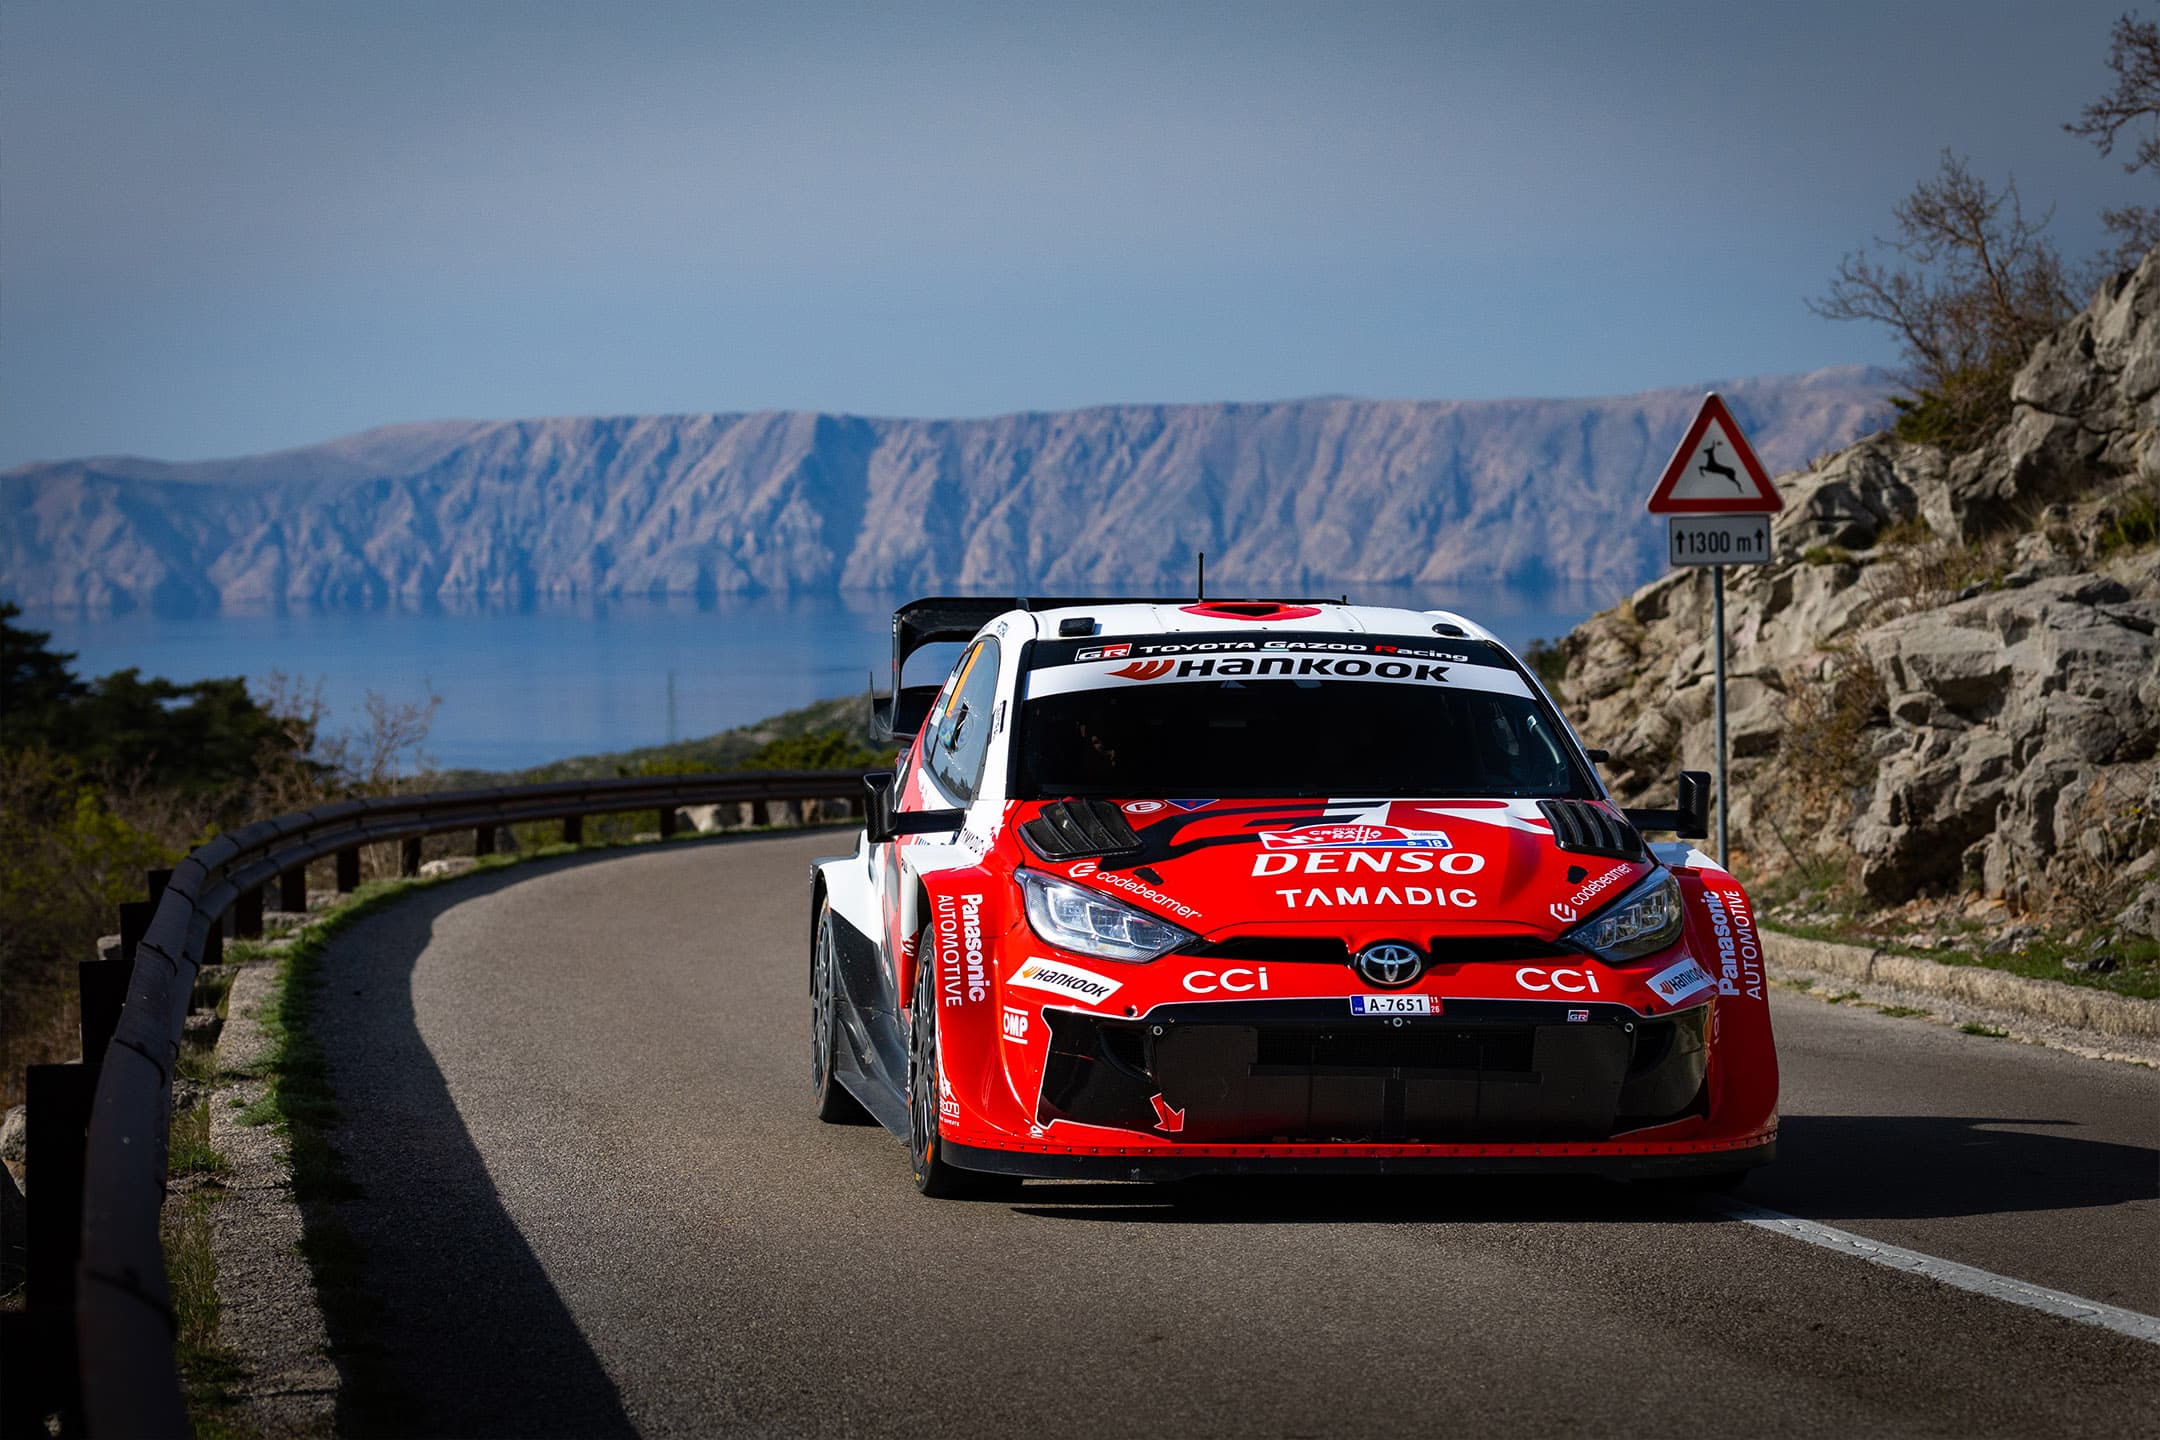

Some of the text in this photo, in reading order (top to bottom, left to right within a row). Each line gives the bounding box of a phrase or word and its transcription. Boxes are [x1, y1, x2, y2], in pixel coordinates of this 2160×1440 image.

[1688, 531, 1751, 553] 1300 m
[1077, 641, 1469, 662] GR TOYOTA GAZOO Racing
[1425, 839, 1443, 847] 18
[1251, 851, 1485, 877] DENSO
[1096, 871, 1202, 919] codebeamer
[1275, 886, 1478, 908] TAMADIC
[1570, 863, 1632, 906] codebeamer
[937, 894, 963, 1008] AUTOMOTIVE
[960, 893, 990, 1002] Panasonic
[1700, 890, 1740, 996] Panasonic
[1723, 890, 1762, 1001] AUTOMOTIVE
[1370, 998, 1424, 1012] A-7651
[1568, 1012, 1588, 1021] GR
[1003, 1012, 1028, 1038] OMP
